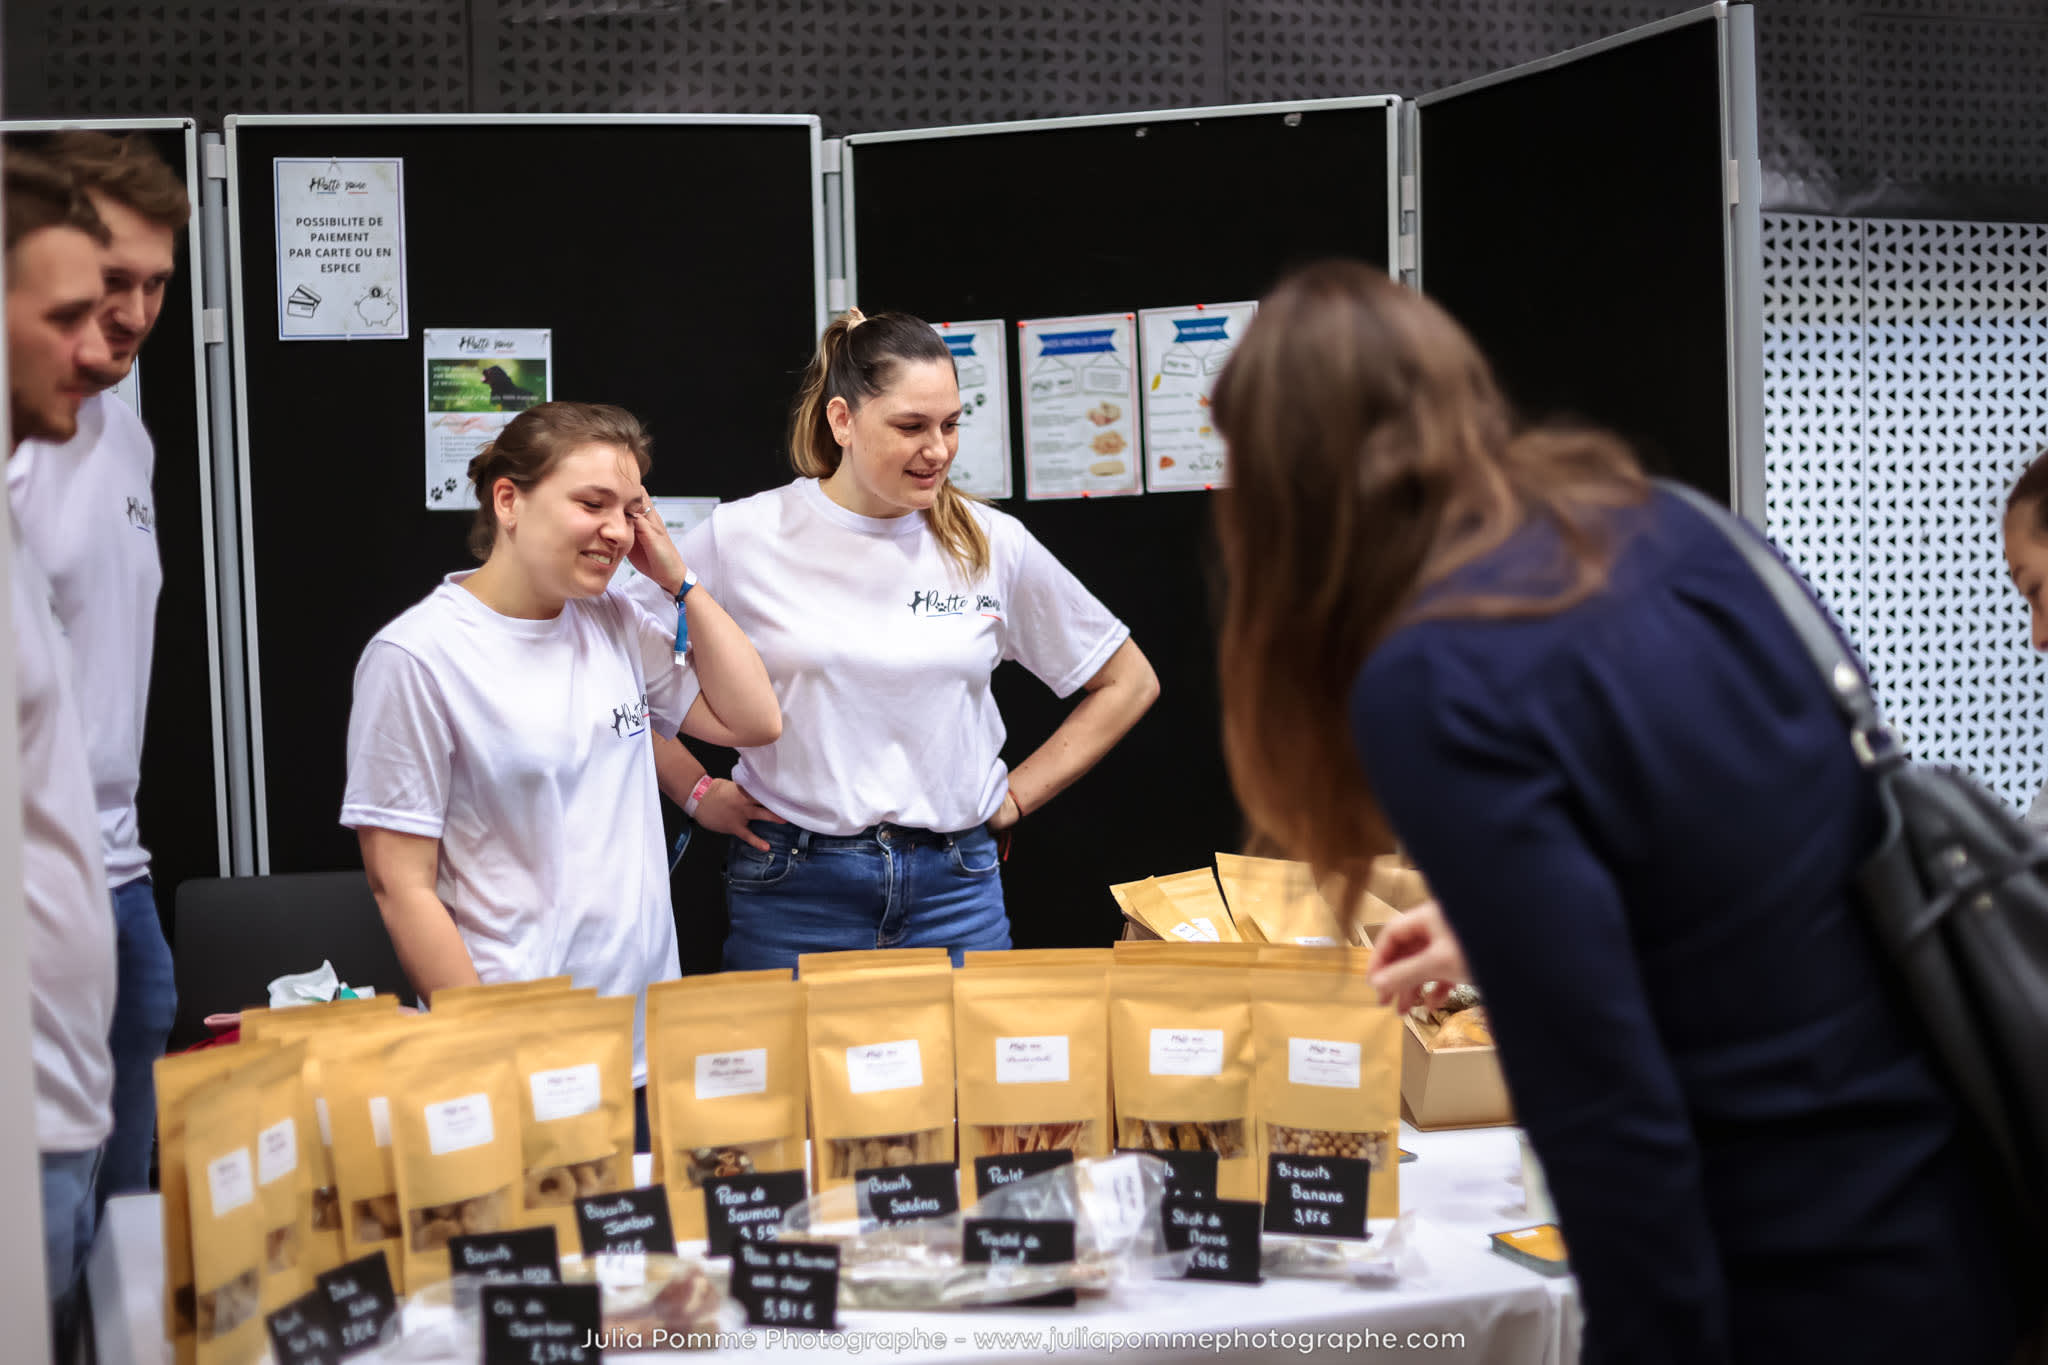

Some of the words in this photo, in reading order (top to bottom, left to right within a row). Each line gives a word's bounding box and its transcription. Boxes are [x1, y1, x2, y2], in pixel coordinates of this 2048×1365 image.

[296, 217, 365, 228] POSSIBILITE
[368, 217, 383, 227] DE
[310, 232, 369, 242] PAIEMENT
[289, 248, 311, 258] PAR
[315, 248, 351, 258] CARTE
[355, 248, 372, 258] OU
[376, 247, 391, 257] EN
[320, 263, 361, 273] ESPECE
[1277, 1162, 1330, 1180] Biscuits
[869, 1173, 912, 1193] Biscuits
[1291, 1183, 1344, 1203] Banane
[584, 1198, 634, 1219] Biscuits
[890, 1196, 940, 1215] Sardines
[728, 1206, 780, 1223] Saumon
